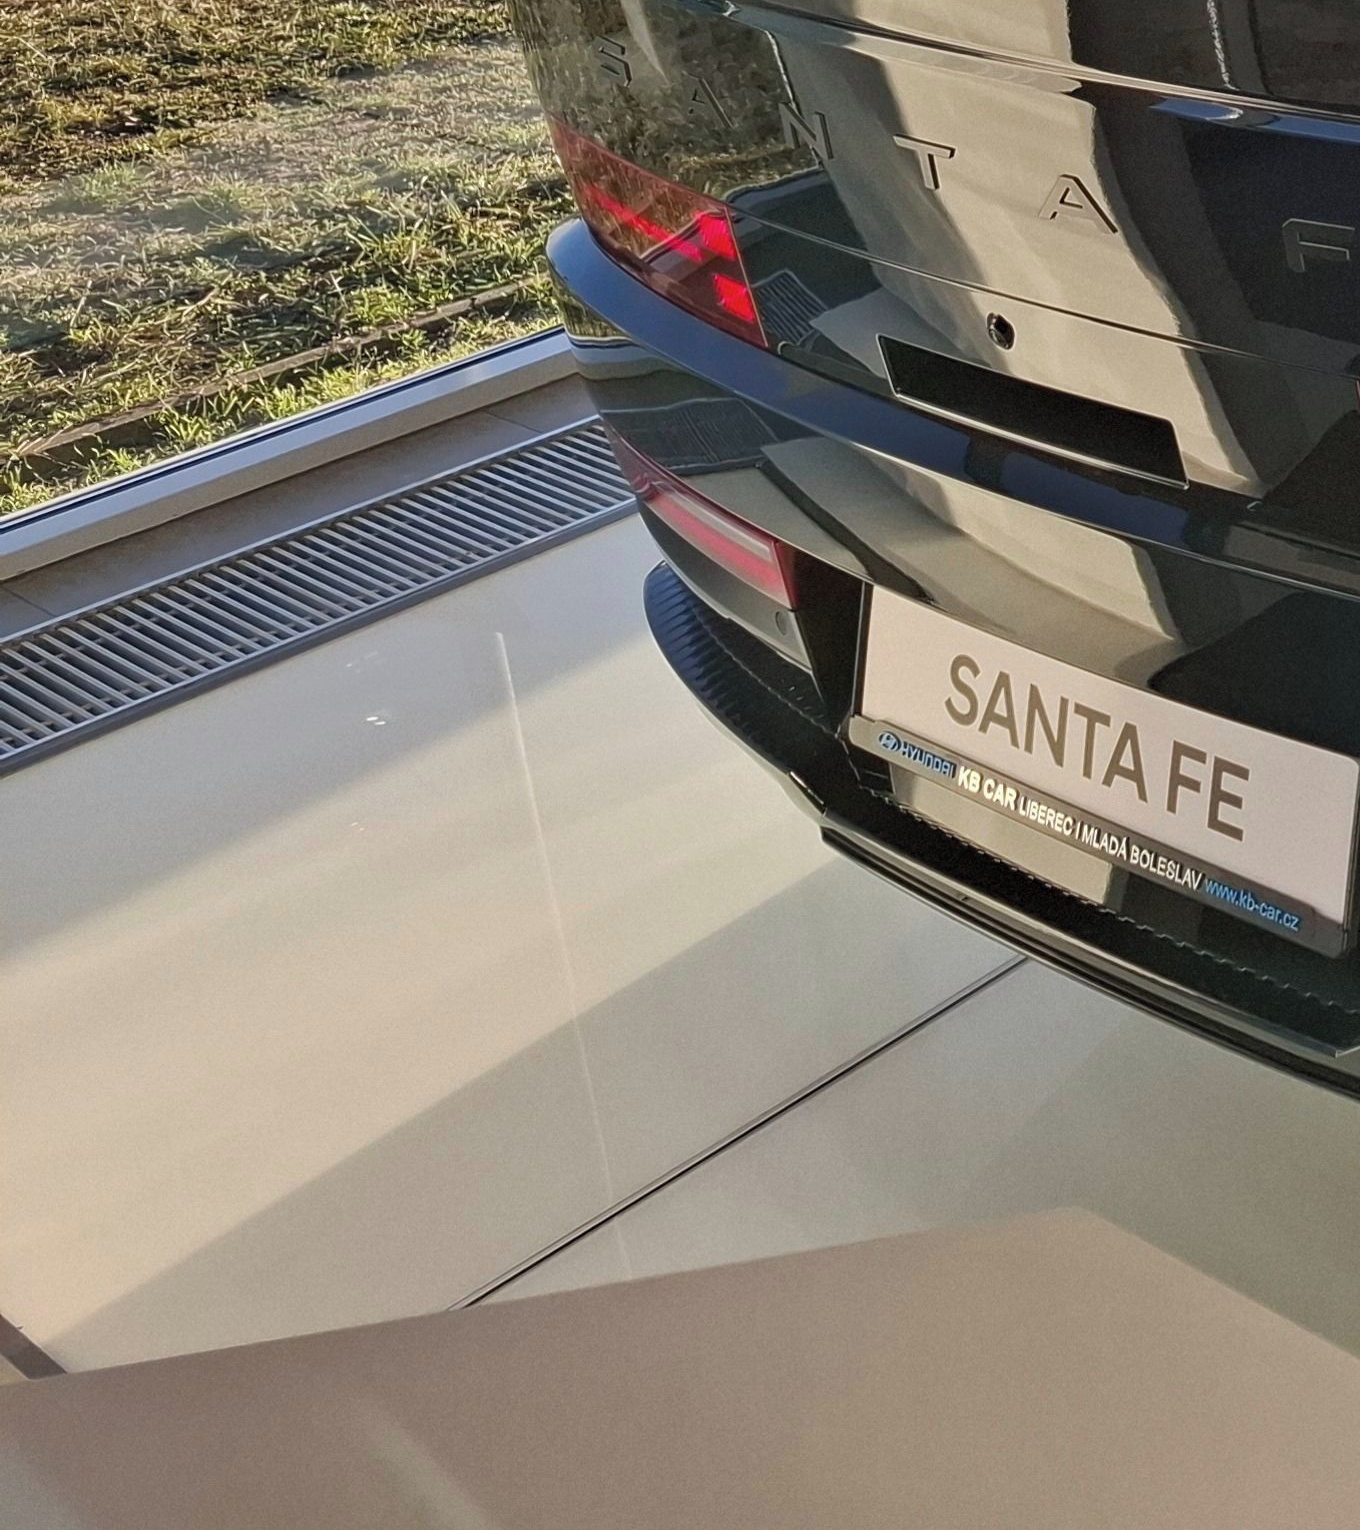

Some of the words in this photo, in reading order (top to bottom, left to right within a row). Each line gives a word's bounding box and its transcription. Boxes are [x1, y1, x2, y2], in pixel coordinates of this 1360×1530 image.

[944, 654, 1148, 803] SANTA
[1166, 739, 1251, 842] FE
[957, 765, 983, 794] KB
[983, 778, 1018, 811] CAR
[1018, 796, 1074, 838] LIBEREC
[1081, 823, 1128, 861] MLADÁ
[1129, 844, 1203, 891] BOLESLAV
[1204, 878, 1300, 932] www.kb-car.cz
